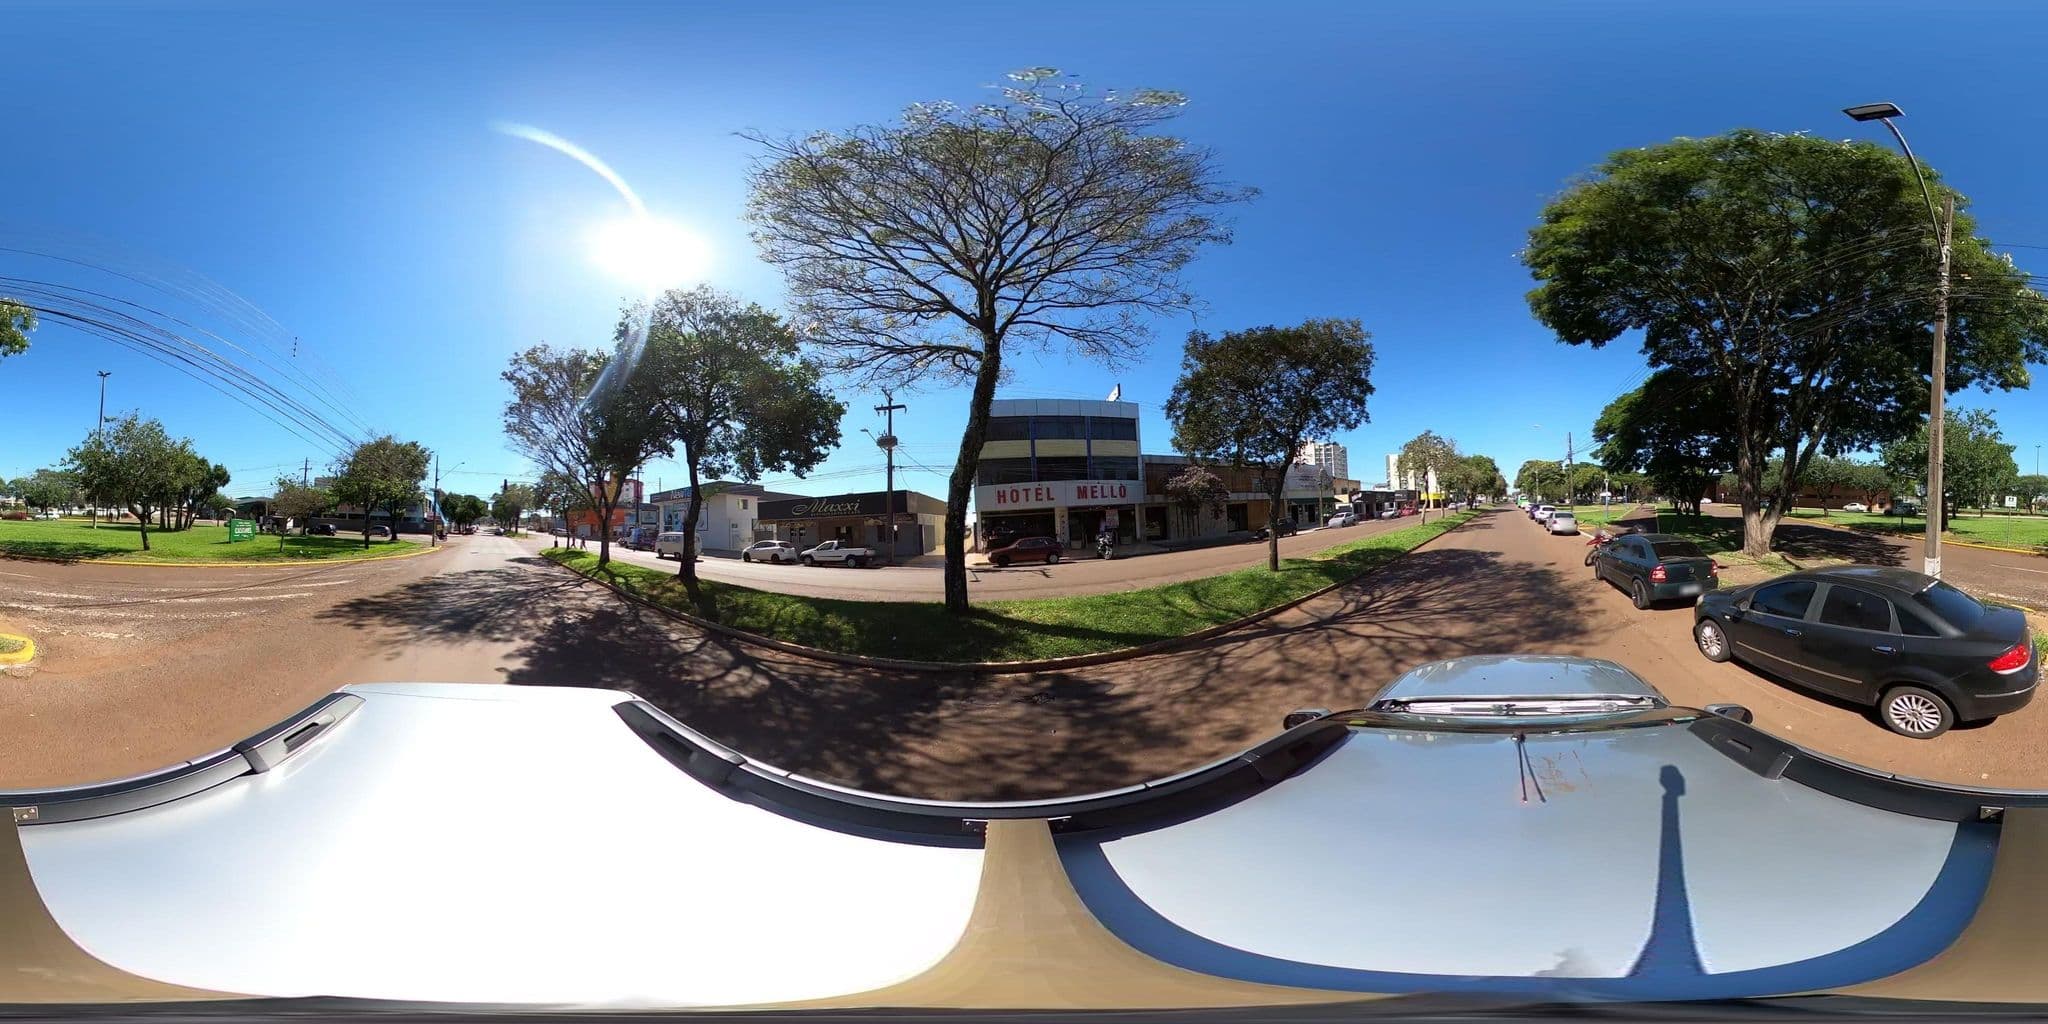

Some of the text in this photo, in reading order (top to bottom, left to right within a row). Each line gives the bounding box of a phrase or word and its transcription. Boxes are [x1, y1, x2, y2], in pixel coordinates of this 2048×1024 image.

[997, 485, 1126, 504] HOTEL MELLO
[792, 498, 860, 516] Maxxi
